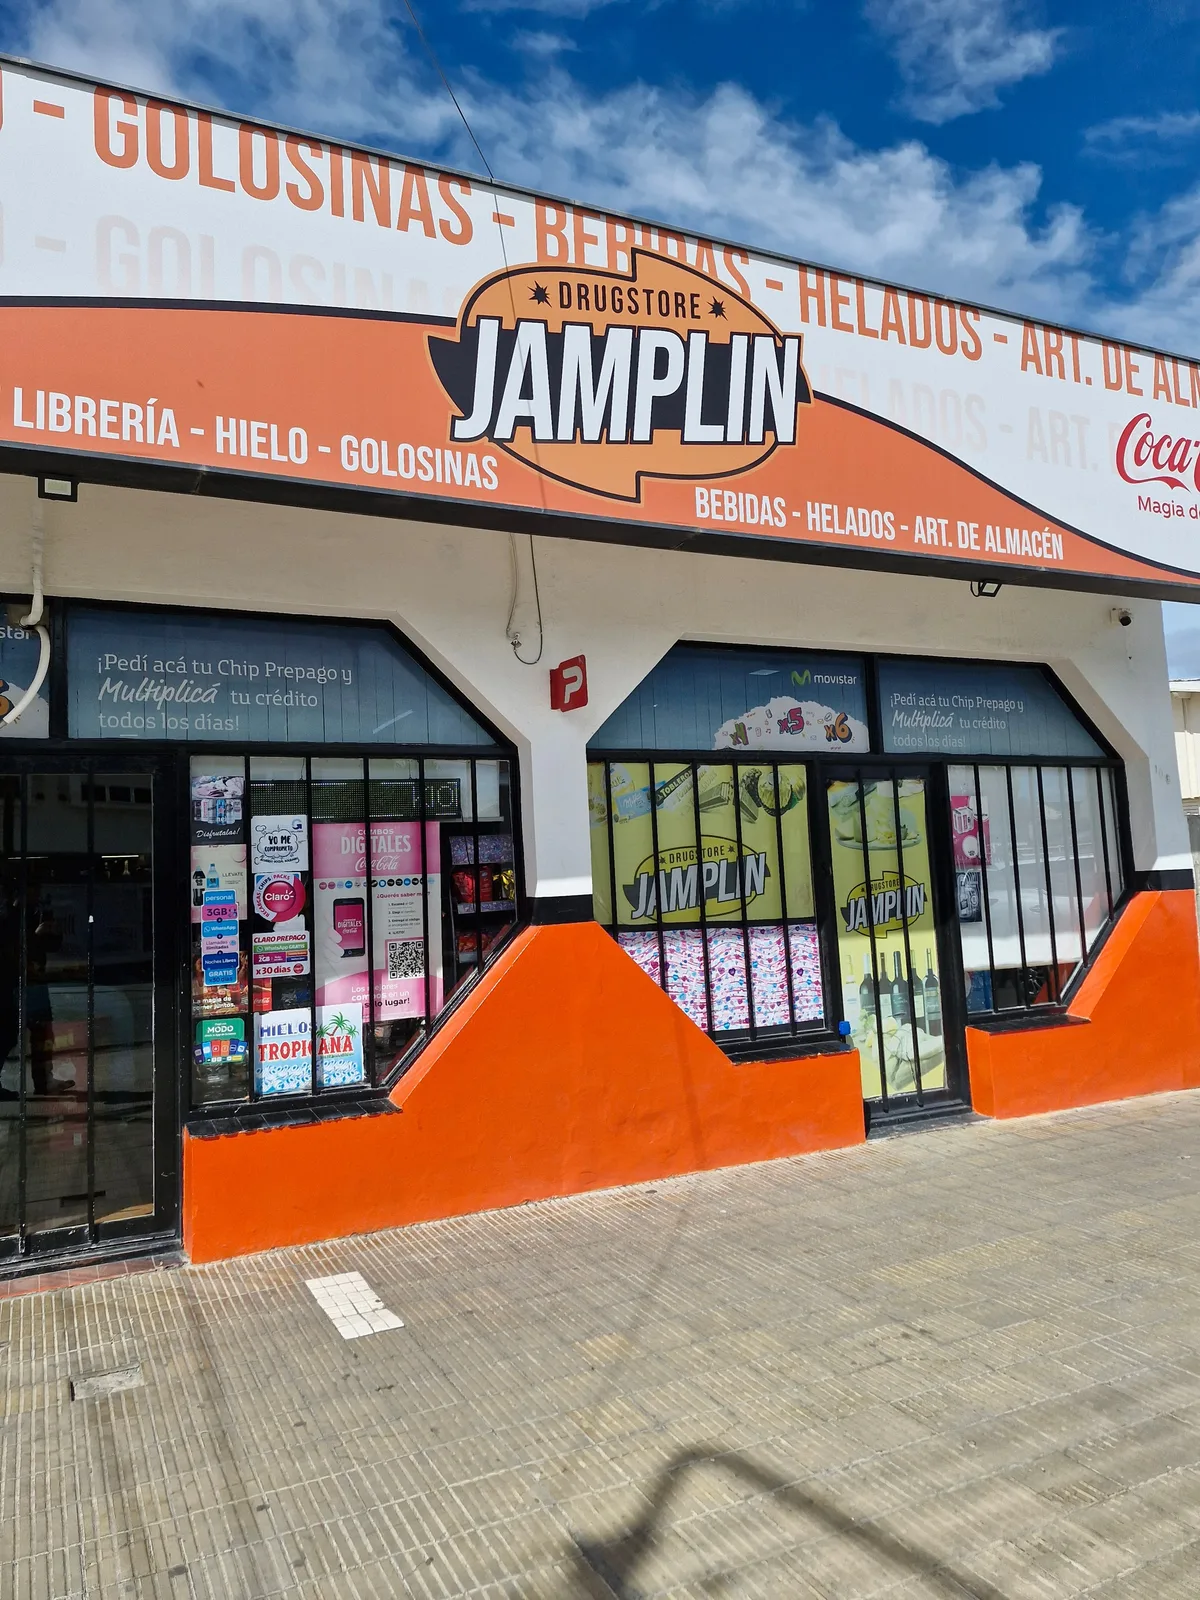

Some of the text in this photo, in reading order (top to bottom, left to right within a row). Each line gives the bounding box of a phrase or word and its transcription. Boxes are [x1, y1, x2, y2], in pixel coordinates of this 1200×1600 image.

[93, 84, 474, 246] GOLOSINAS
[799, 265, 983, 361] HELADOS
[1021, 321, 1092, 386] ART.
[1102, 340, 1143, 397] DE
[558, 281, 701, 319] DRUGSTORE
[453, 318, 799, 443] JAMPLIN
[13, 386, 180, 448] LIBRERÍA
[215, 416, 308, 465] HIELO
[340, 434, 499, 490] GOLOSINAS
[1137, 495, 1184, 519] Magia
[695, 486, 787, 528] BEBIDAS
[806, 501, 896, 541] HELADOS
[914, 516, 953, 547] ART.
[957, 521, 981, 551] DE
[984, 525, 1064, 561] ALMACÉN
[97, 653, 352, 685] ¡Pedí acá tu Chip Prepago y
[813, 674, 857, 685] movistar
[98, 677, 318, 710] Multiplicá tu crédito
[890, 693, 1024, 713] ¡Pedí acá tu Chip Prepago y
[98, 712, 240, 732] todos los días!
[777, 707, 805, 735] x5
[824, 712, 853, 744] x6
[892, 709, 1007, 733] Multiplicá tu crédito
[893, 734, 966, 748] todos los días!
[195, 827, 241, 839] Disfrutalas!
[268, 835, 292, 845] YO ME
[264, 845, 294, 853] COMPROMETO
[341, 835, 412, 855] DIGTALES
[355, 855, 401, 873] Coa-Cola
[258, 877, 272, 891] CHIPS
[272, 873, 291, 881] PACKS
[868, 878, 900, 893] RUGSTORE
[205, 893, 234, 902] personal
[264, 892, 291, 901] Claro
[206, 907, 228, 917] 3GB
[211, 923, 237, 931] WhatsApp
[253, 934, 306, 944] CLARO PREPAGO
[208, 969, 234, 978] GRATIS
[262, 967, 273, 975] 30
[367, 983, 399, 992] ejores
[351, 992, 387, 1001] comos
[364, 998, 410, 1009] slo lugar!
[207, 1025, 234, 1034] MODO
[260, 1021, 314, 1038] HIELO
